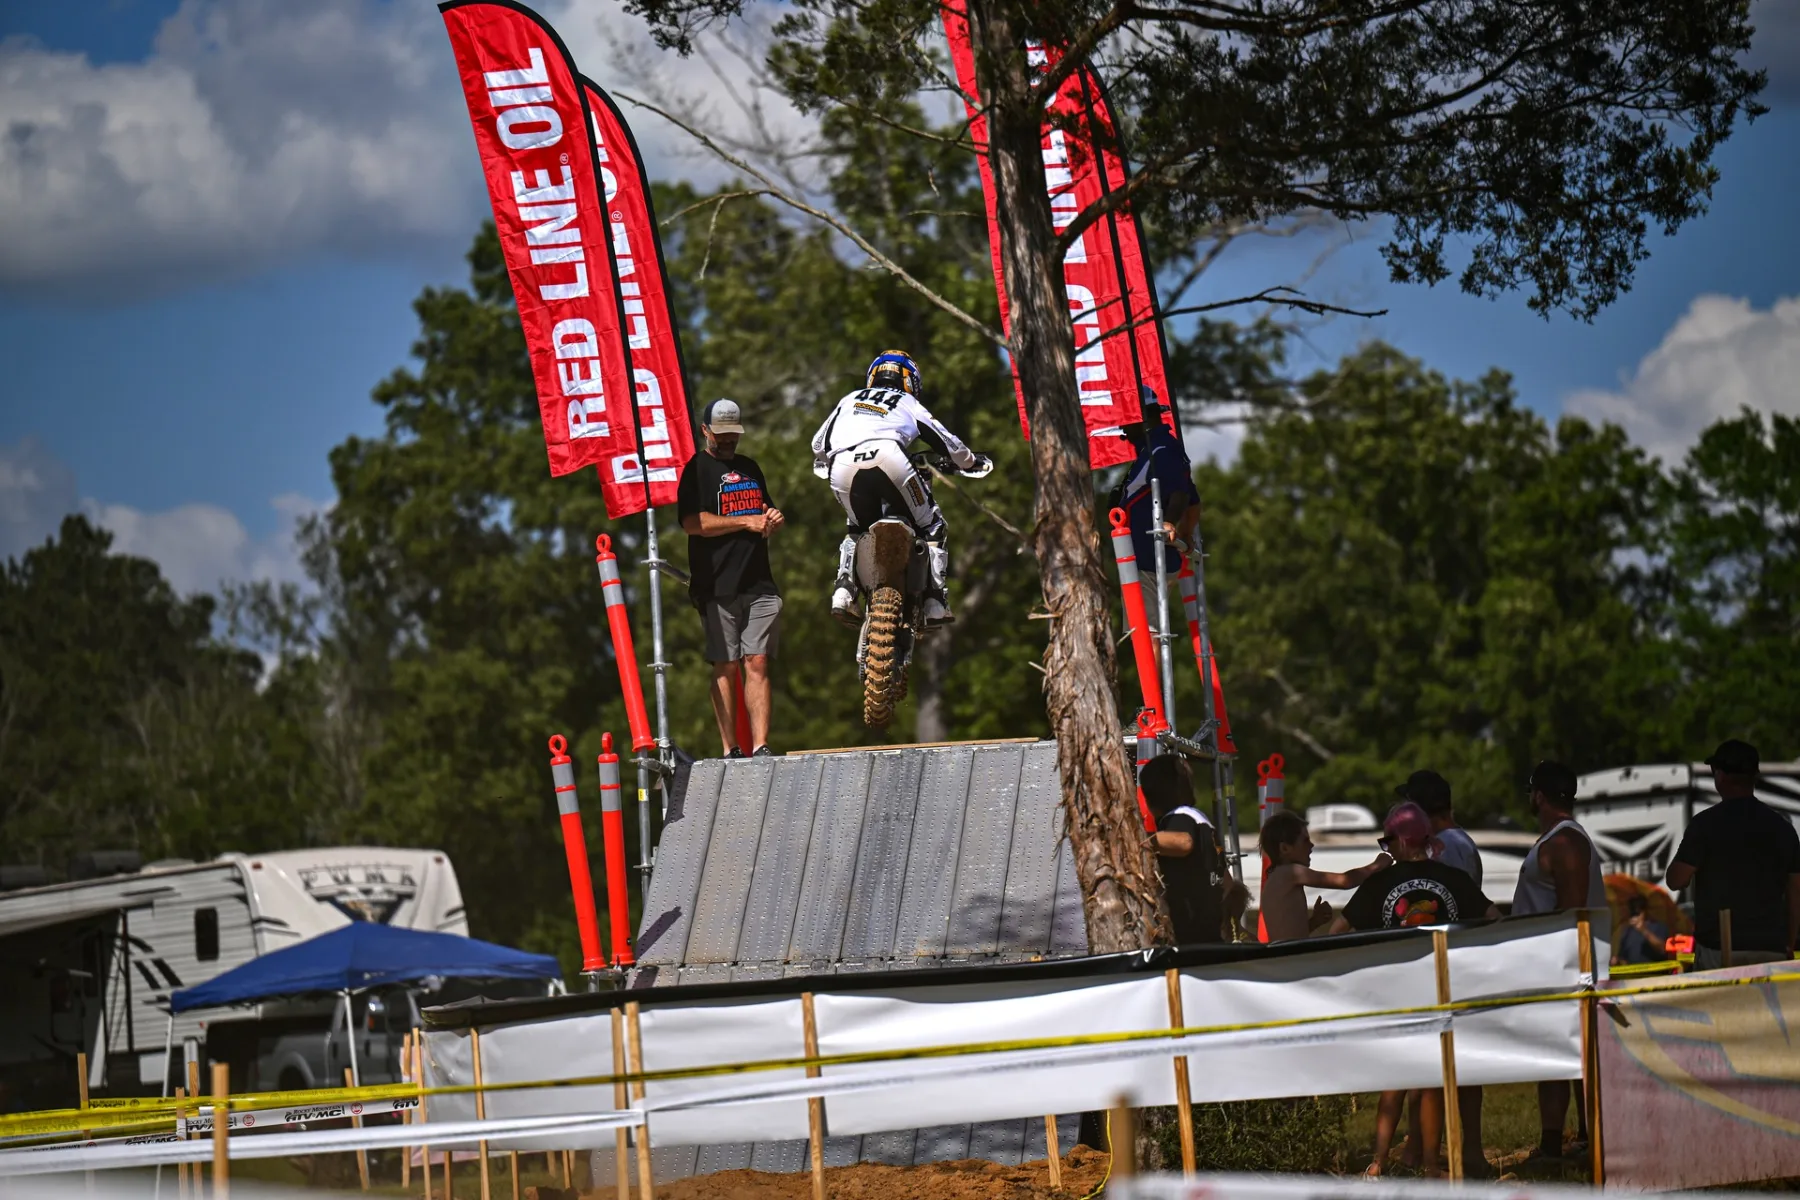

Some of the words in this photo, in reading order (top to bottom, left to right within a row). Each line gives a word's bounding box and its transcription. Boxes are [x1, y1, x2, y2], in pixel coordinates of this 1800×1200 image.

[483, 47, 564, 151] OIL
[552, 317, 611, 441] RED
[854, 388, 903, 412] 444
[853, 449, 880, 463] FLY
[723, 481, 760, 493] AMERICA
[721, 489, 763, 504] NATIONA
[721, 499, 763, 515] ENDUR
